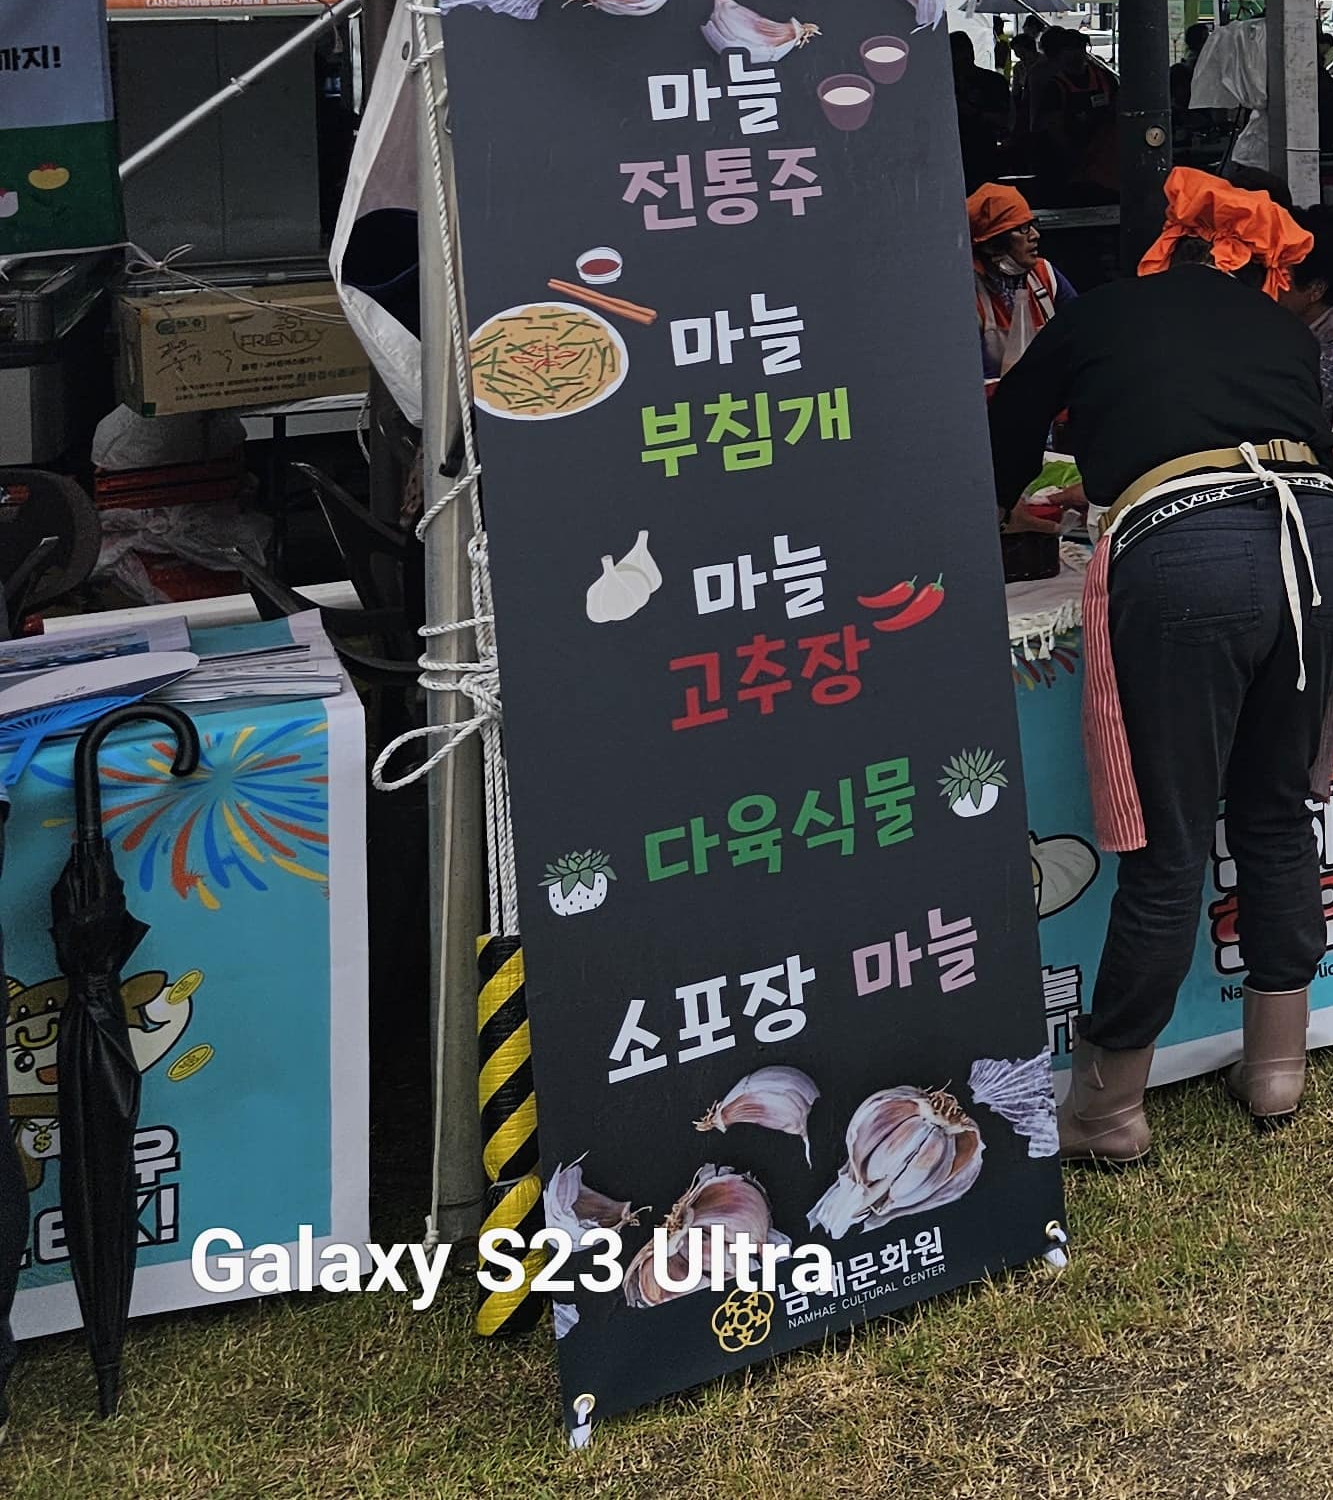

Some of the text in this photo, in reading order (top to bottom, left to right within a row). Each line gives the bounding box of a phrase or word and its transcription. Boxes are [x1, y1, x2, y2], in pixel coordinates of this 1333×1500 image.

[648, 53, 782, 135] 마늘
[619, 147, 823, 231] 전통주
[670, 293, 805, 376] 마늘
[641, 387, 852, 477] 부침개
[692, 534, 827, 620] 마늘
[668, 624, 871, 732] 고추장
[644, 757, 916, 883] 다육식물
[608, 907, 978, 1084] 소포장 마늘
[788, 1264, 947, 1330] NAMHAE CULTURAL CENTER
